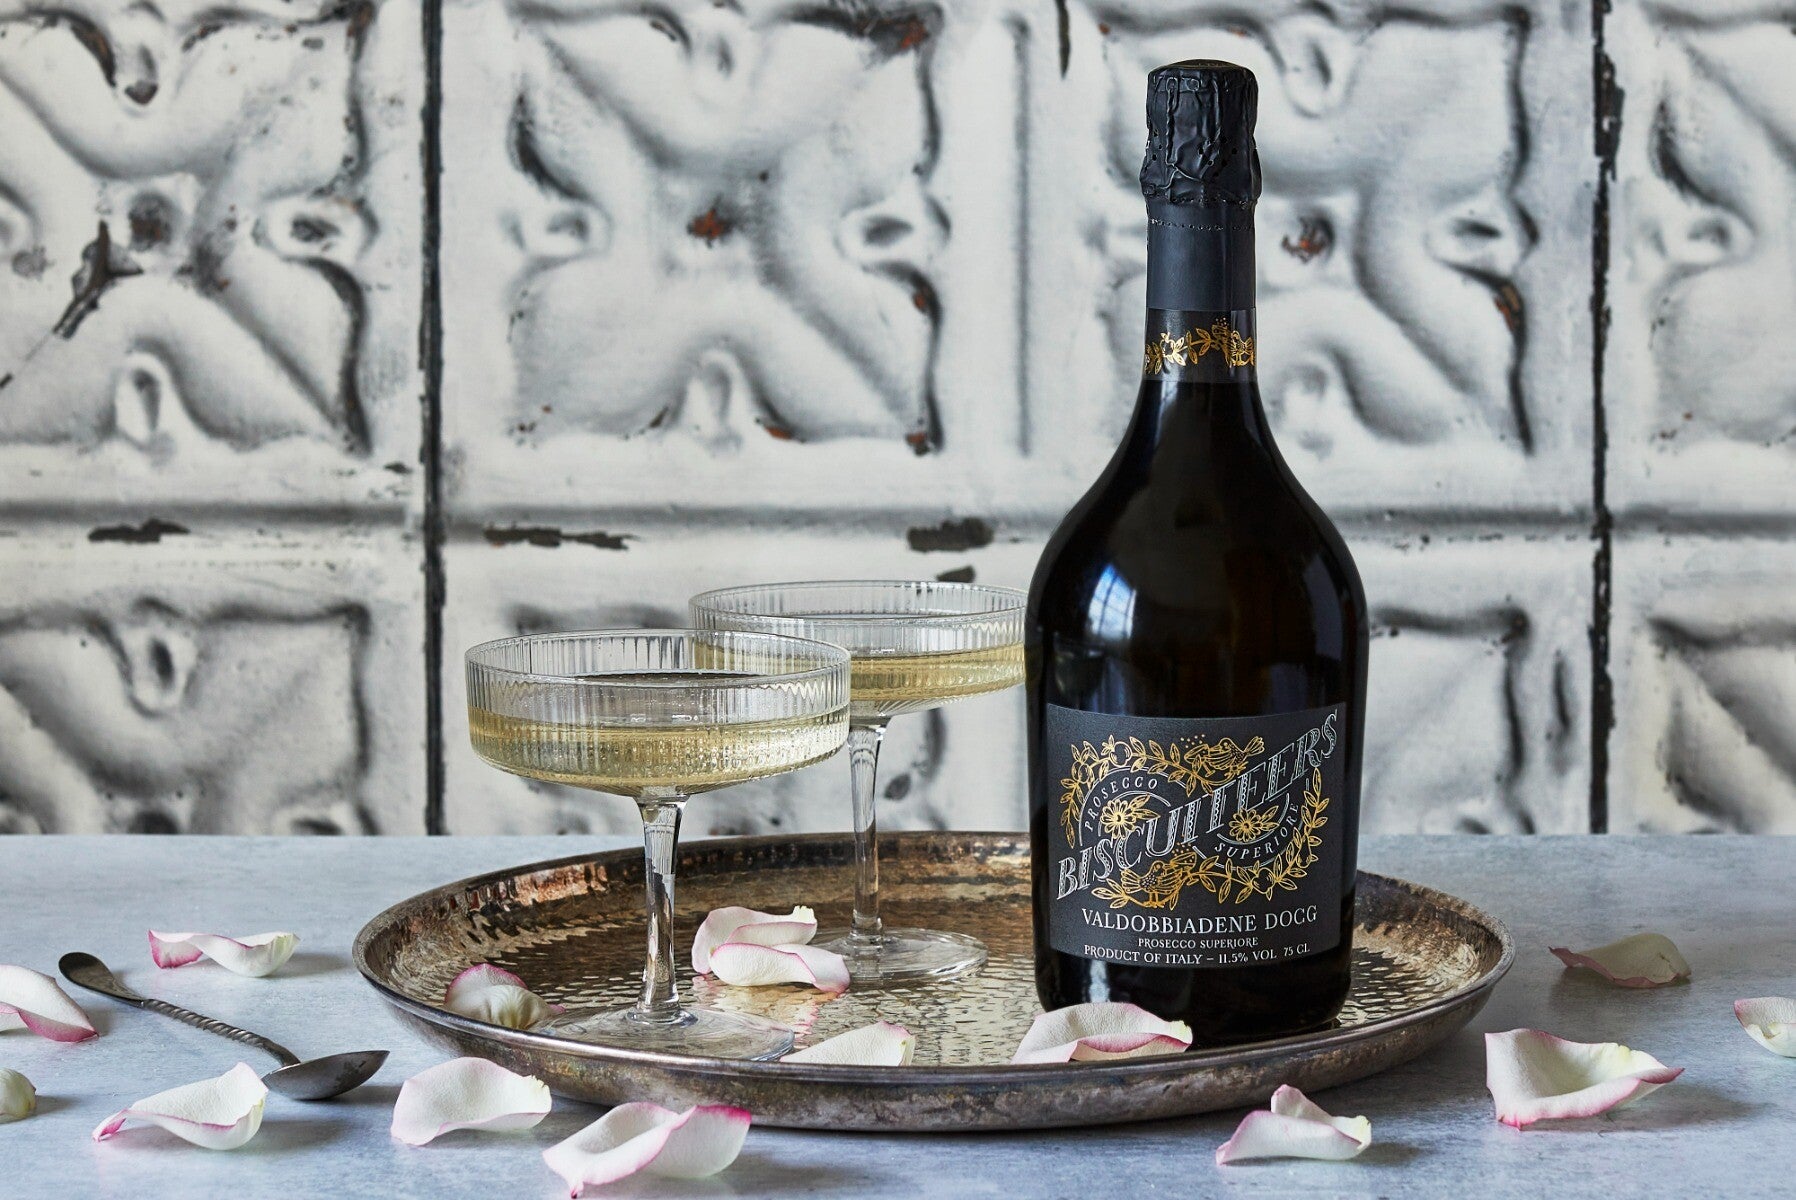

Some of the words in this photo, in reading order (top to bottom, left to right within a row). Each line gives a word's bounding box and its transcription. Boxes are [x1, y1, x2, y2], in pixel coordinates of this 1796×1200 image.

[1056, 709, 1338, 900] BISCUITEERS
[1084, 775, 1159, 832] PROSECCO
[1214, 803, 1299, 860] SUPERIORE
[1082, 908, 1257, 934] VALDOBBIADENE
[1264, 905, 1318, 931] DOCG
[1084, 945, 1141, 962] PRODUCT
[1144, 952, 1162, 963] OF
[1165, 953, 1203, 964] ITALY
[1252, 949, 1277, 962] VOL
[1284, 946, 1294, 957] 75
[1296, 944, 1310, 954] CL
[1138, 937, 1196, 949] PROSECCO
[1199, 937, 1258, 949] SUPERIORE
